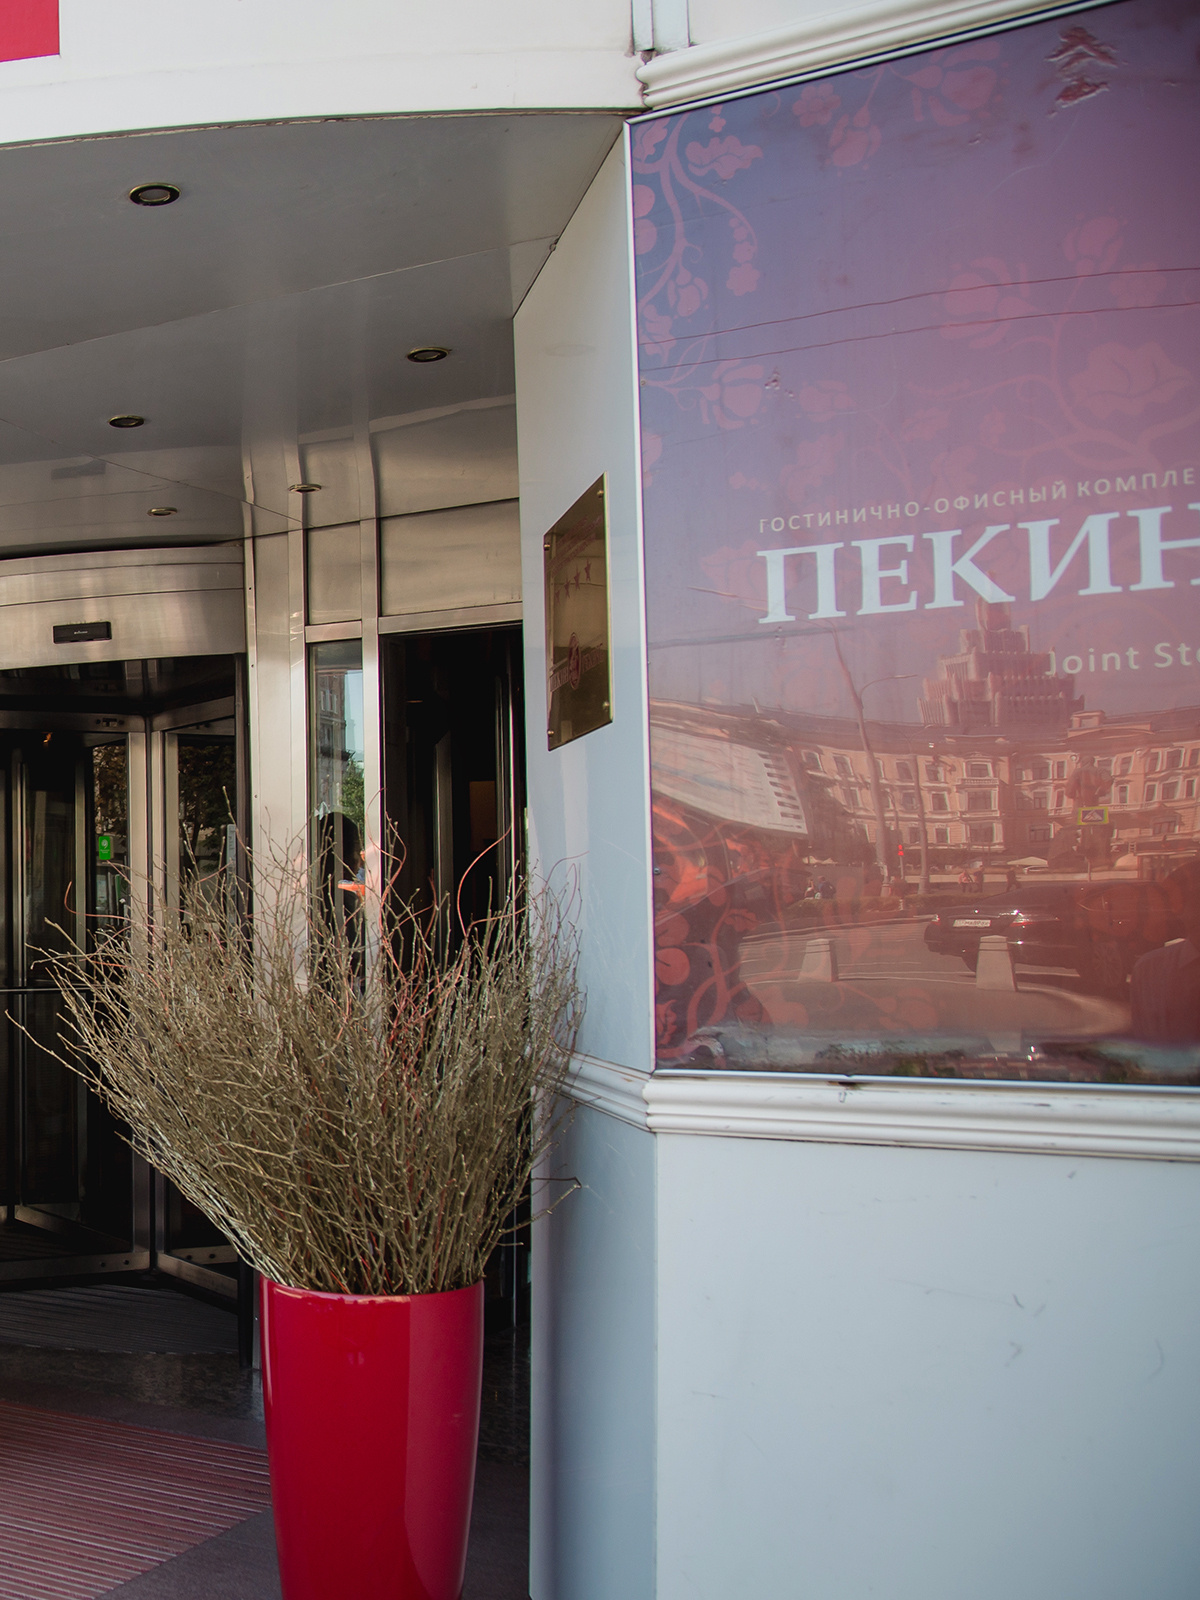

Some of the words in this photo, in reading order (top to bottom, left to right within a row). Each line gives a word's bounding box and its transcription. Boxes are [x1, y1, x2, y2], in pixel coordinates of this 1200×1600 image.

[758, 480, 1067, 533] ГОСТИНИЧНО-ОФИСНЫЙ
[1076, 467, 1196, 498] КОМПЛЕ
[756, 502, 1200, 624] ПЕКИН
[1045, 647, 1140, 677] Joint
[1154, 642, 1200, 668] St
